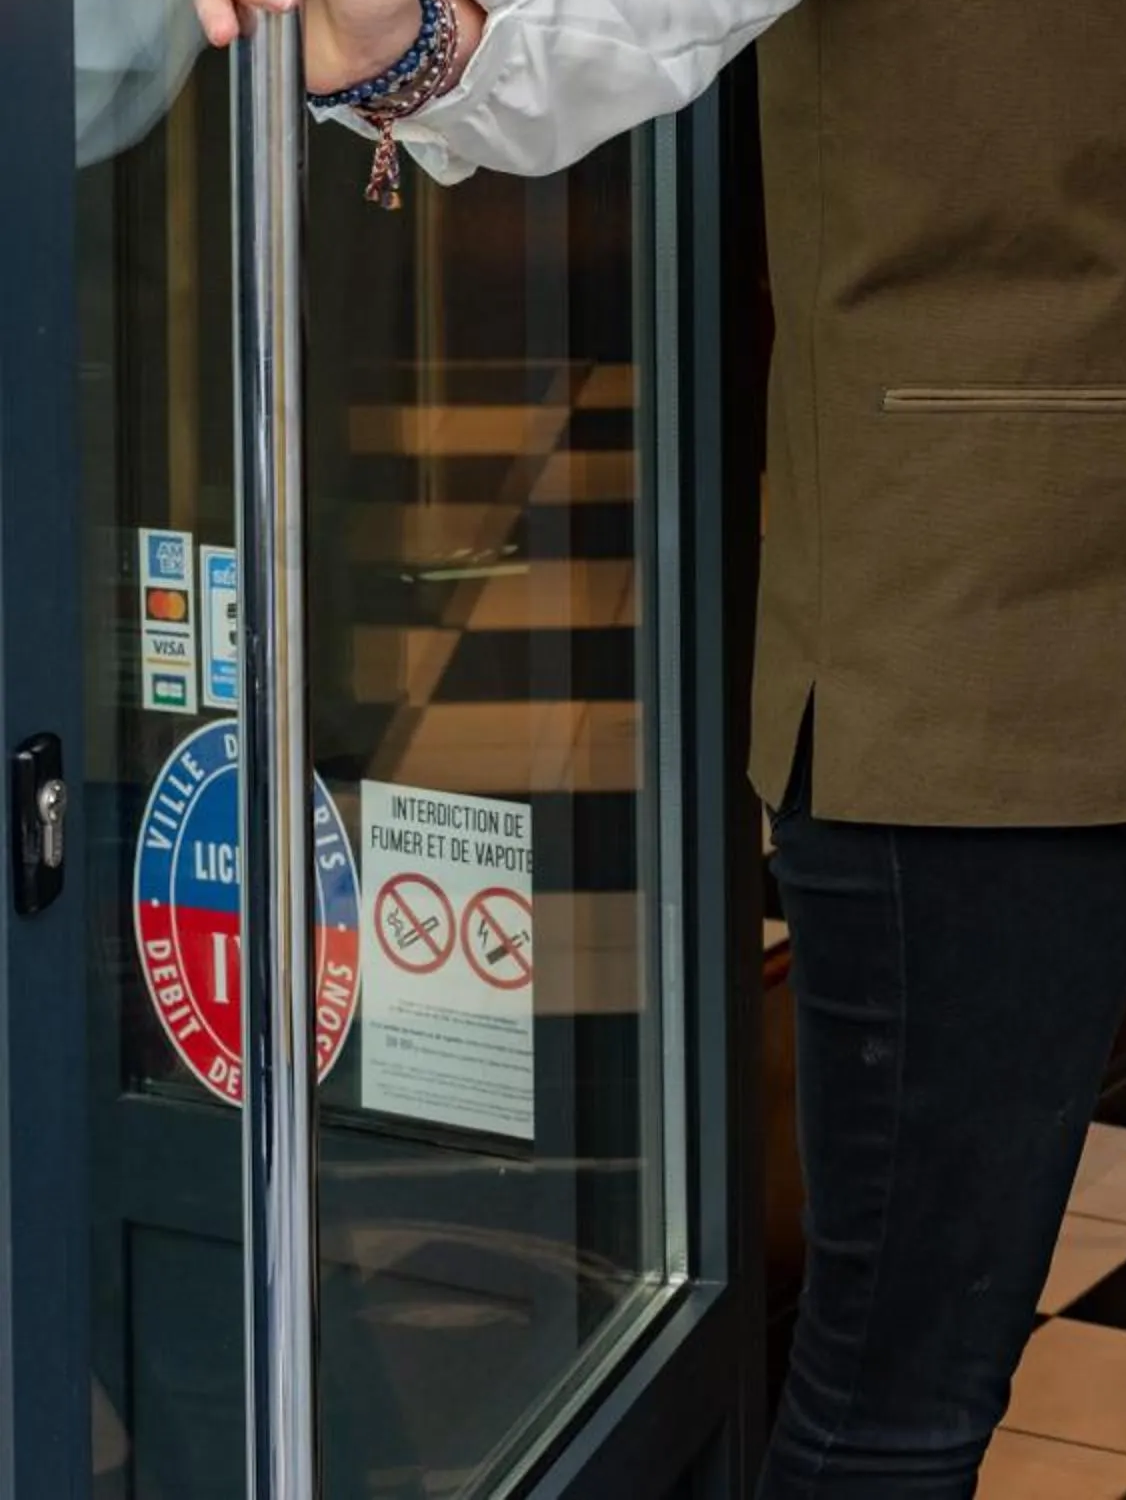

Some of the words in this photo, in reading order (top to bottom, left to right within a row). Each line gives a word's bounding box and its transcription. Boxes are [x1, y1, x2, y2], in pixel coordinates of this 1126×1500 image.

[156, 541, 186, 559] AM
[160, 558, 186, 574] EX
[152, 639, 186, 657] VISA
[146, 751, 205, 851] VILLE
[223, 733, 241, 759] D
[314, 804, 346, 870] RIS
[392, 796, 500, 835] INTERDICTION
[503, 812, 525, 839] DE
[194, 840, 240, 885] LIC
[371, 825, 423, 858] FUMER
[427, 833, 446, 860] ET
[451, 837, 471, 863] DE
[212, 931, 241, 1004] I
[146, 938, 202, 1041] DEBIT
[207, 1056, 242, 1095] DE
